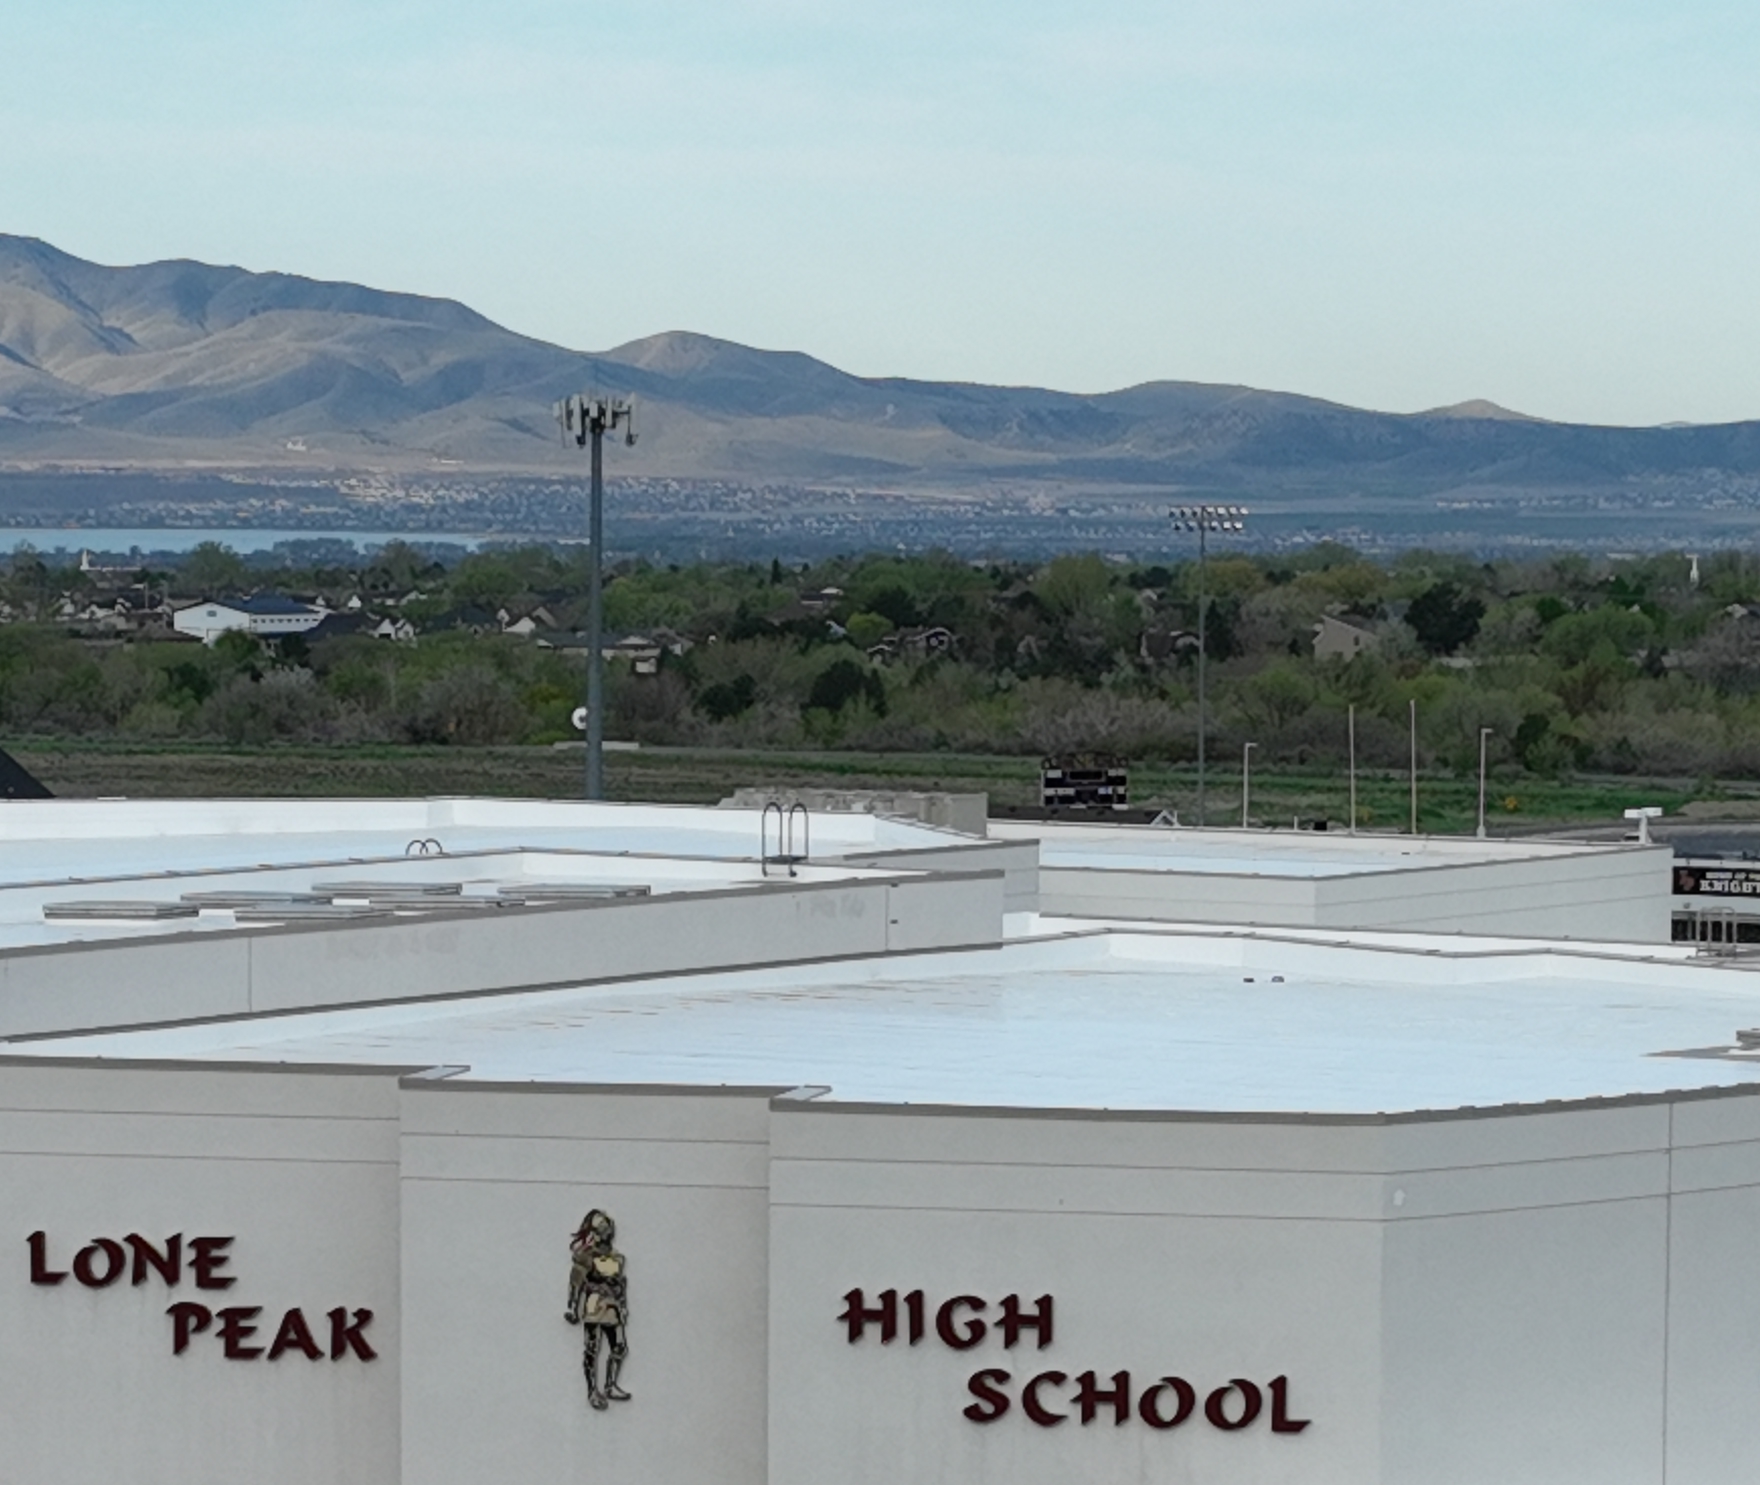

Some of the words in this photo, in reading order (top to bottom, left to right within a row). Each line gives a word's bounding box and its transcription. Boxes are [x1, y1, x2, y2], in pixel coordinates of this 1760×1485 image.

[25, 1230, 238, 1292] LONE
[165, 1301, 379, 1364] PEAK
[836, 1287, 1054, 1353] HIGH
[962, 1368, 1312, 1436] SCHOOL
